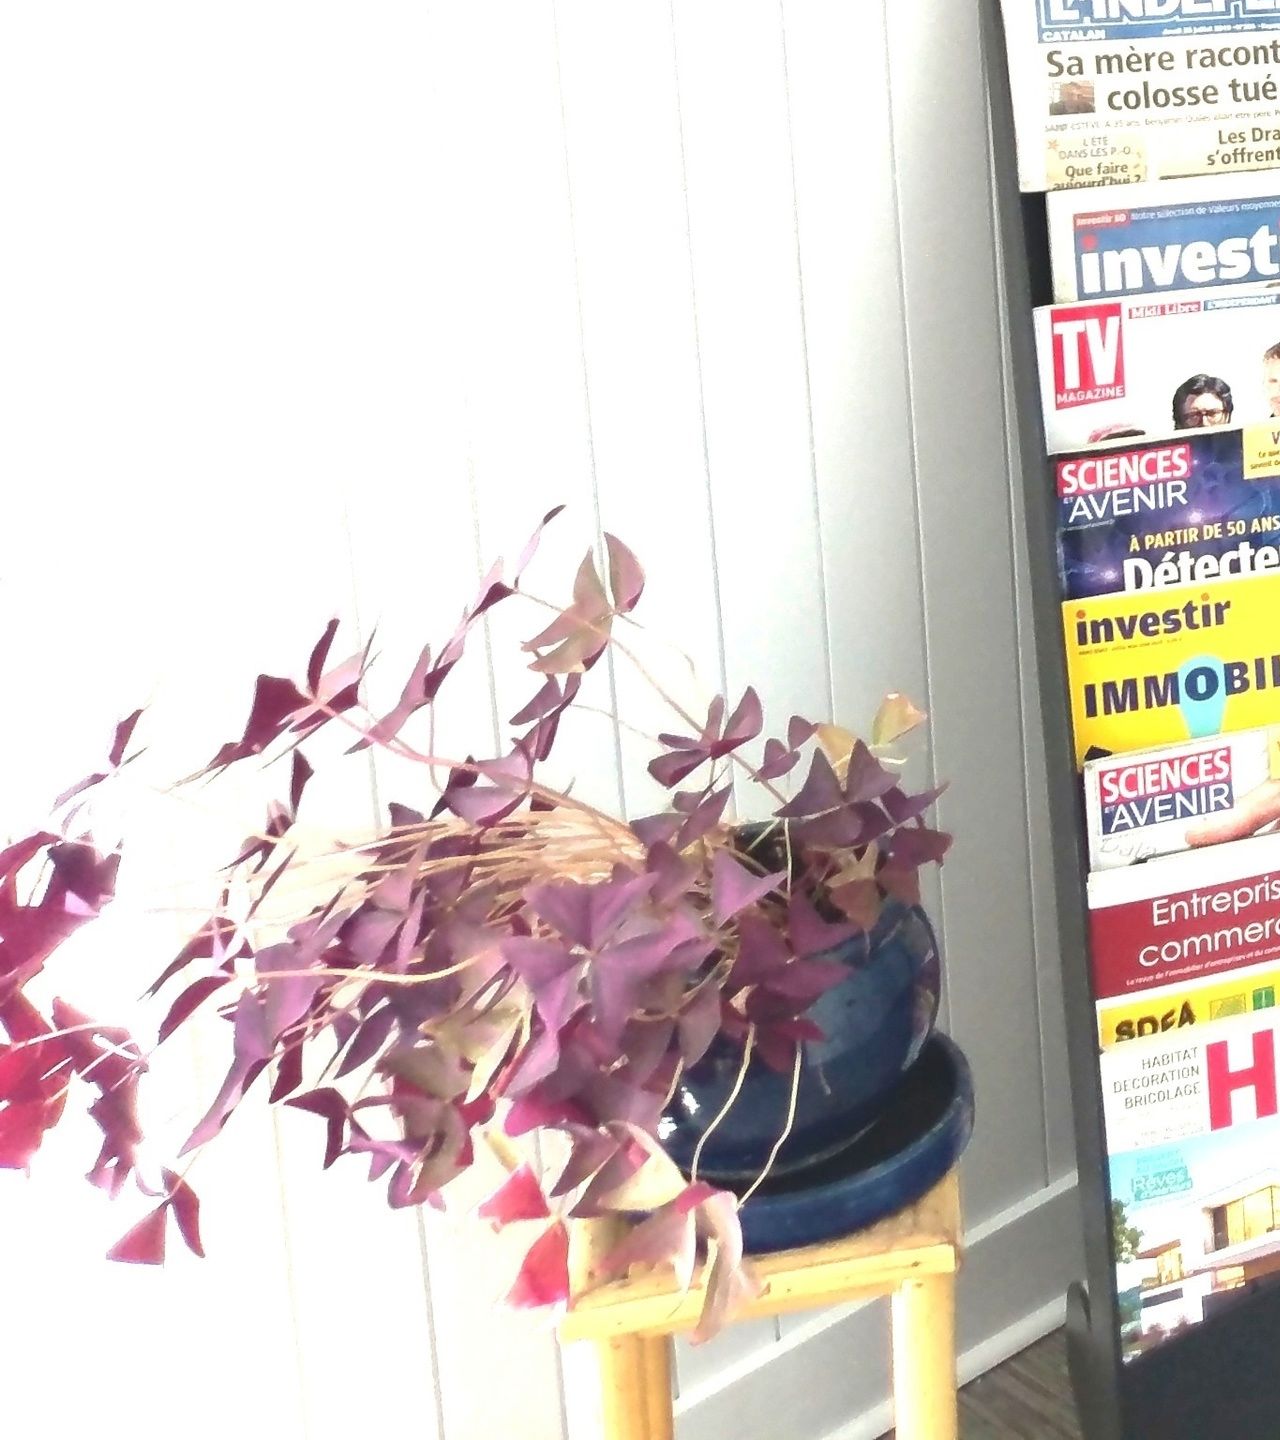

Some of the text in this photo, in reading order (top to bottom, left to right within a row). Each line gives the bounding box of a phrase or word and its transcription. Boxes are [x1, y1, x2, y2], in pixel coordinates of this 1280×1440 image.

[1046, 49, 1085, 78] Sa
[1094, 44, 1176, 75] mère
[1107, 80, 1220, 112] colosse
[1228, 73, 1279, 103] tué
[1218, 129, 1246, 145] Les
[1065, 162, 1128, 179] Que faire
[1054, 315, 1121, 390] TV
[1056, 384, 1126, 405] MAGAZINE
[1061, 447, 1189, 495] SCIENCES
[1068, 480, 1189, 524] AVENIR
[1129, 533, 1140, 552] À
[1145, 527, 1199, 550] PARTIR
[1203, 524, 1222, 541] DE
[1228, 520, 1245, 536] 50
[1076, 592, 1232, 647] investir
[1102, 748, 1231, 804] SCIENCES
[1109, 783, 1233, 834] AVENIR
[1141, 1046, 1200, 1071] HABITAT
[1124, 1082, 1202, 1110] BRICOLAGE
